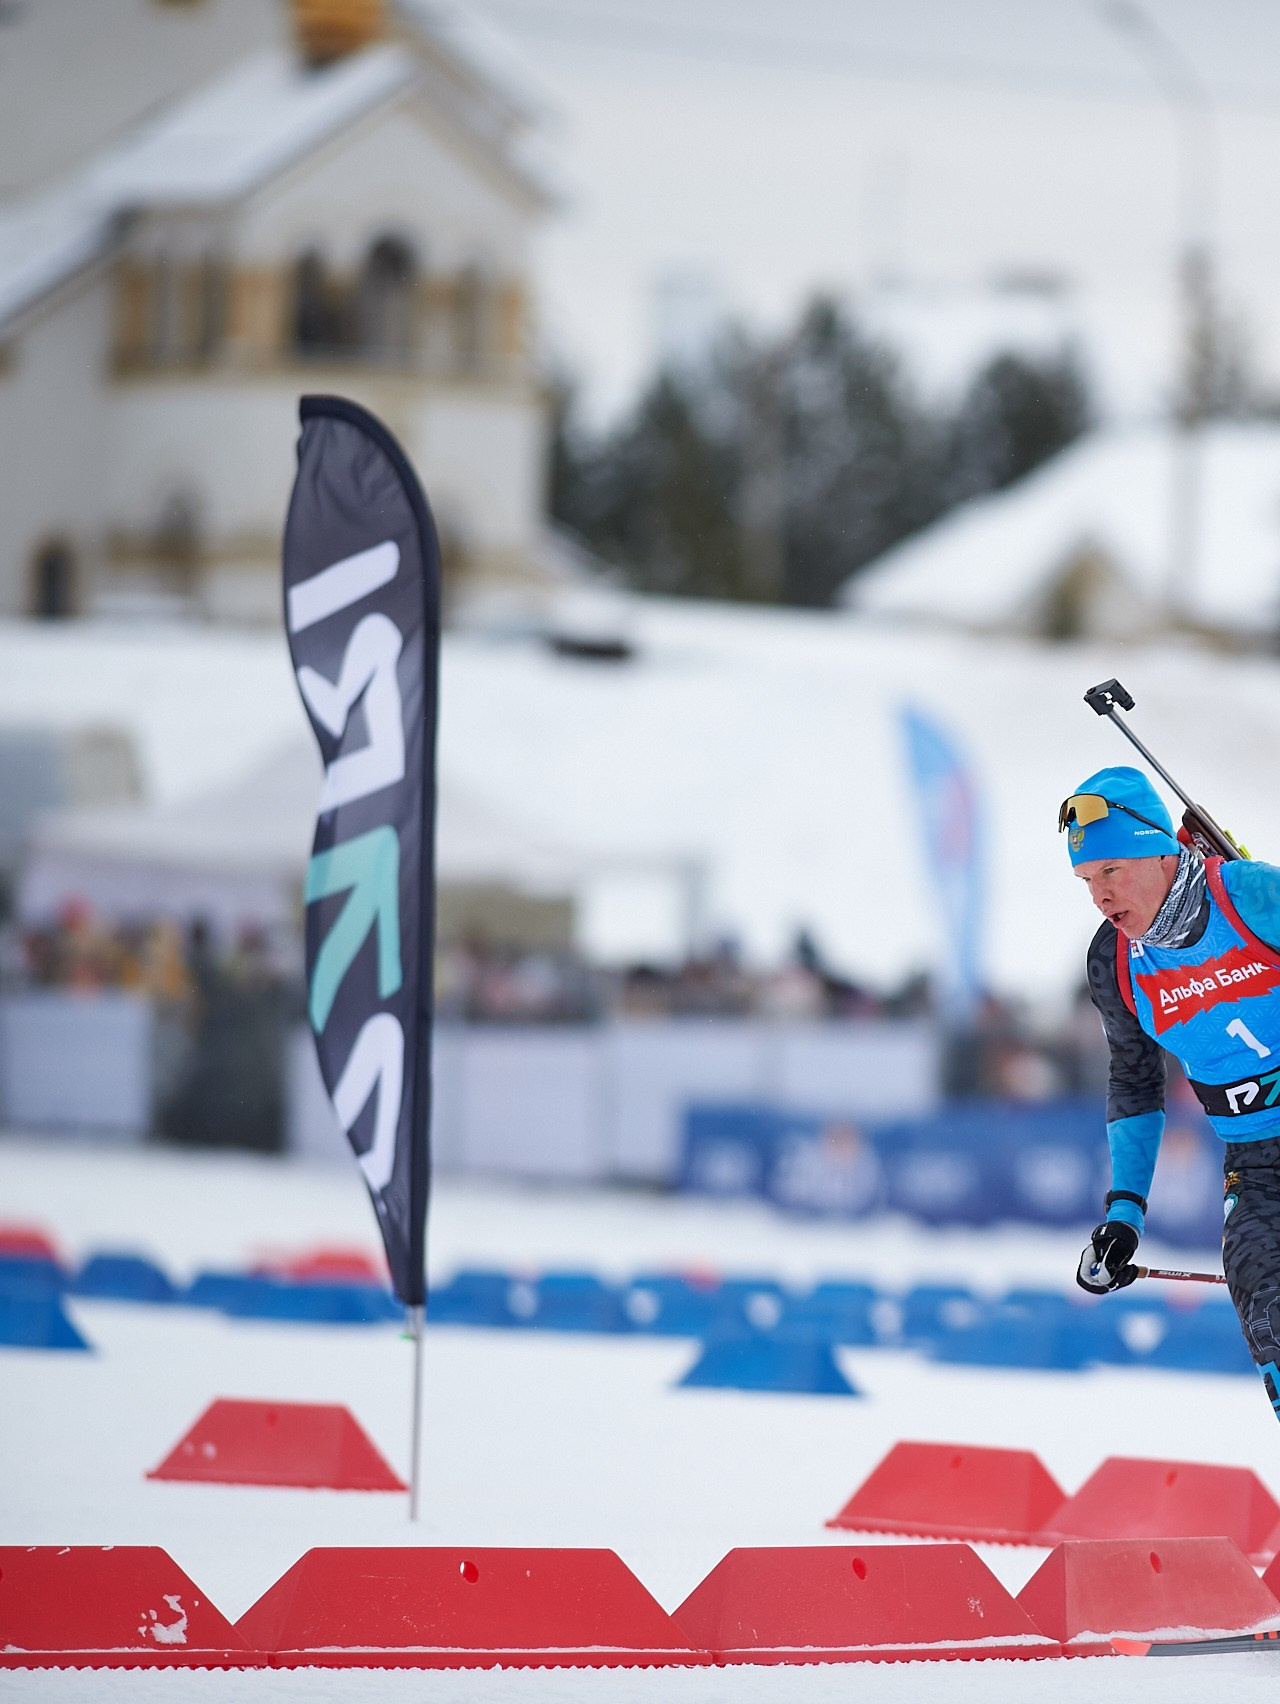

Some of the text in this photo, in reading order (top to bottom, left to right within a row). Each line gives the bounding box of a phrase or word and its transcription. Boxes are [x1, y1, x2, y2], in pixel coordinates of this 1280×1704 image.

[1158, 962, 1270, 1008] Альфа Банк
[1225, 1018, 1271, 1058] 1
